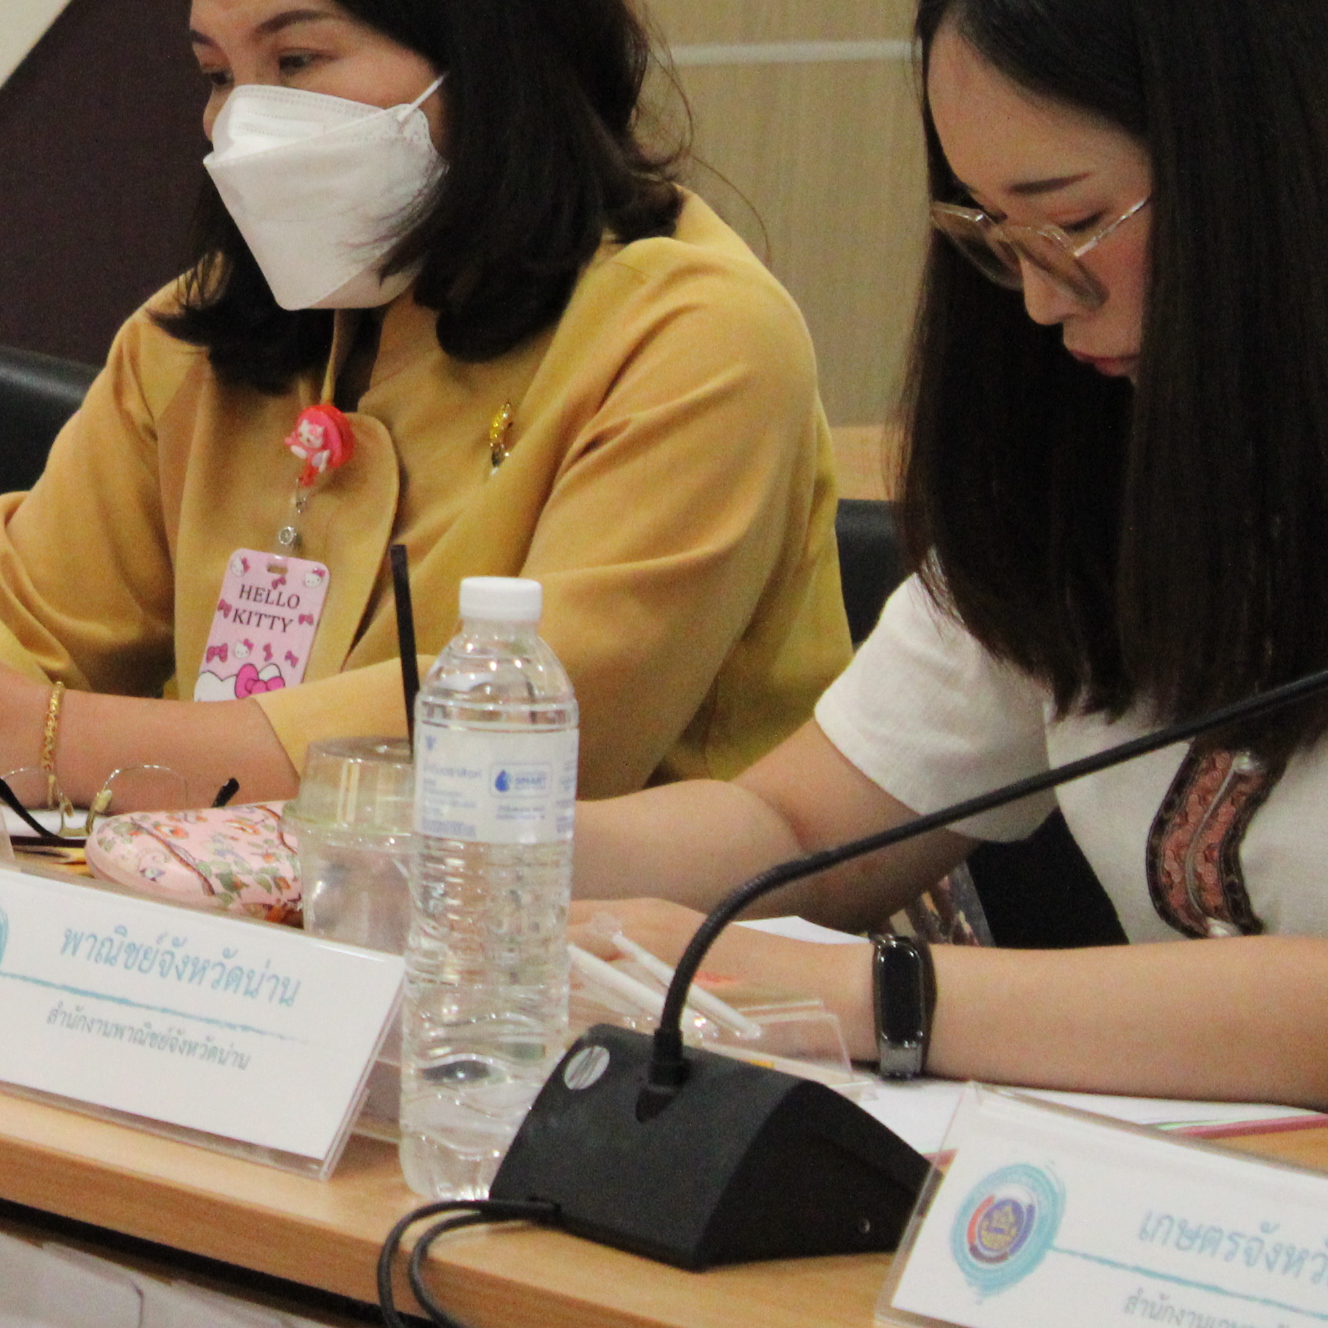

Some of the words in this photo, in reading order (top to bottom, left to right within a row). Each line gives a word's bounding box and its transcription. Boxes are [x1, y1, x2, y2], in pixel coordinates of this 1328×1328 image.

[232, 607, 294, 633] KITTY
[238, 583, 301, 610] HELLO
[60, 924, 302, 1007] พาณิชย์จังหวัดน่าน
[1137, 1209, 1328, 1285] เกษตรจังหว
